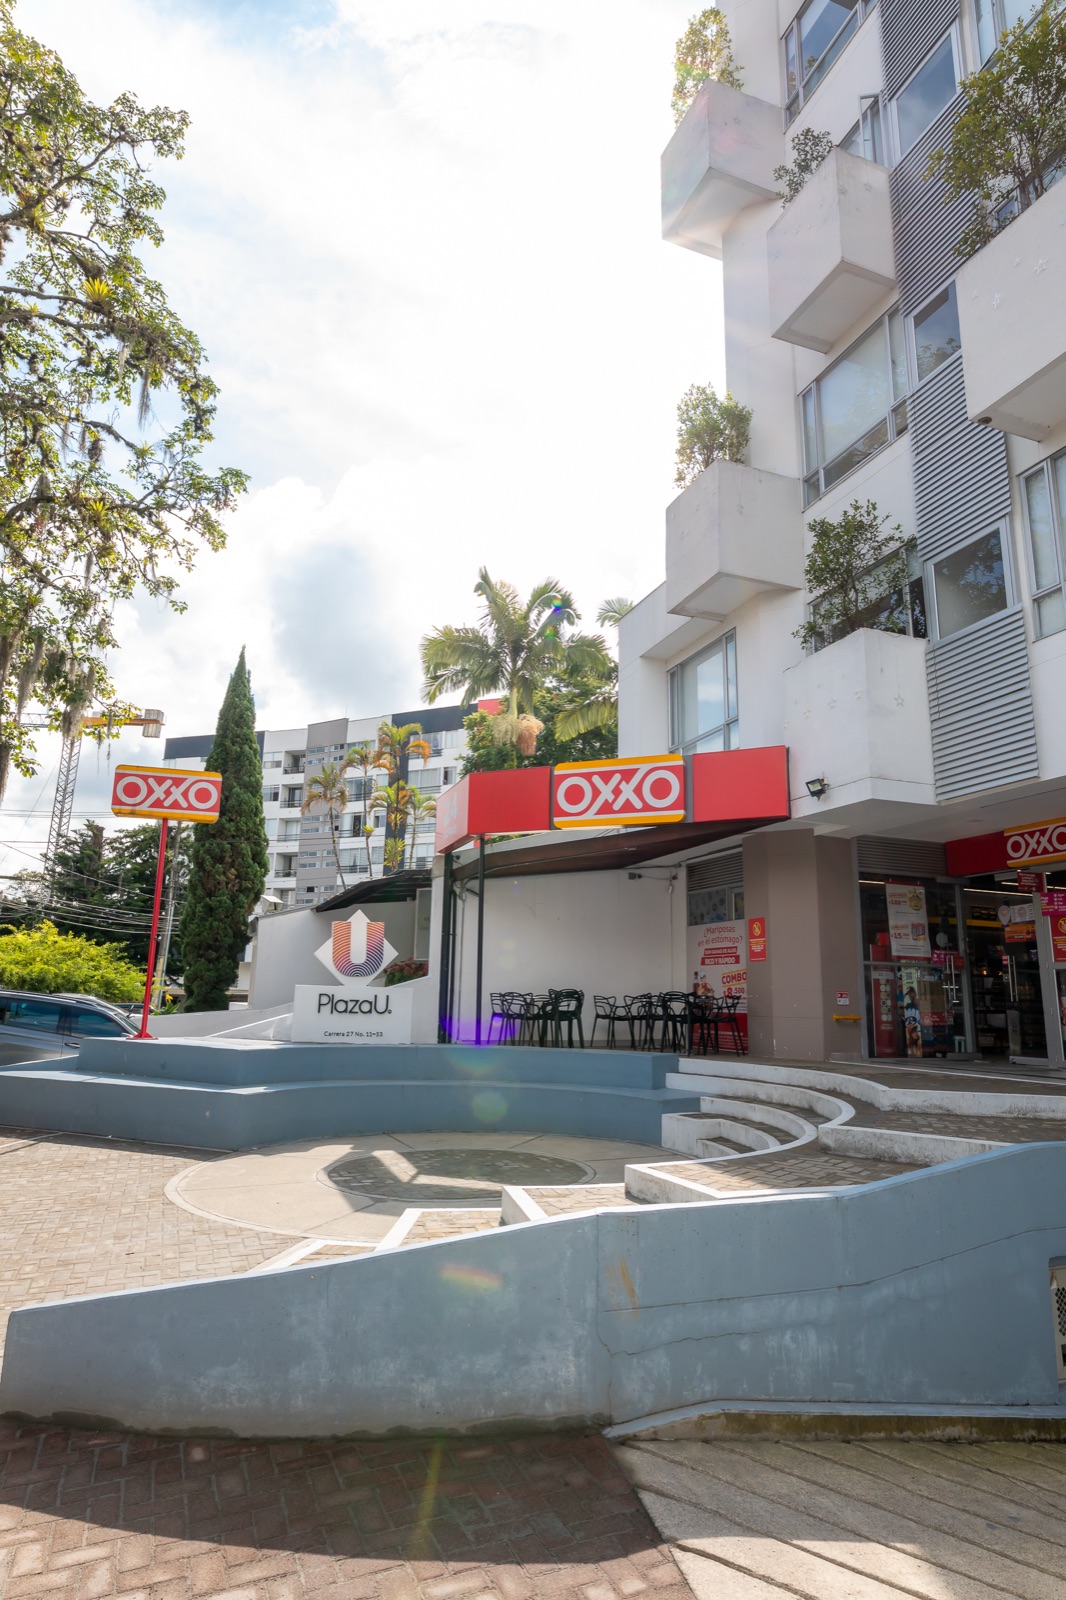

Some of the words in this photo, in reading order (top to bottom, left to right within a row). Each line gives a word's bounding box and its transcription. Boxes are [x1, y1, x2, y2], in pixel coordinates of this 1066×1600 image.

[116, 775, 218, 810] OXXO
[557, 769, 680, 814] OXXO
[704, 925, 736, 938] ¿Mariposas
[721, 971, 747, 985] COMBO
